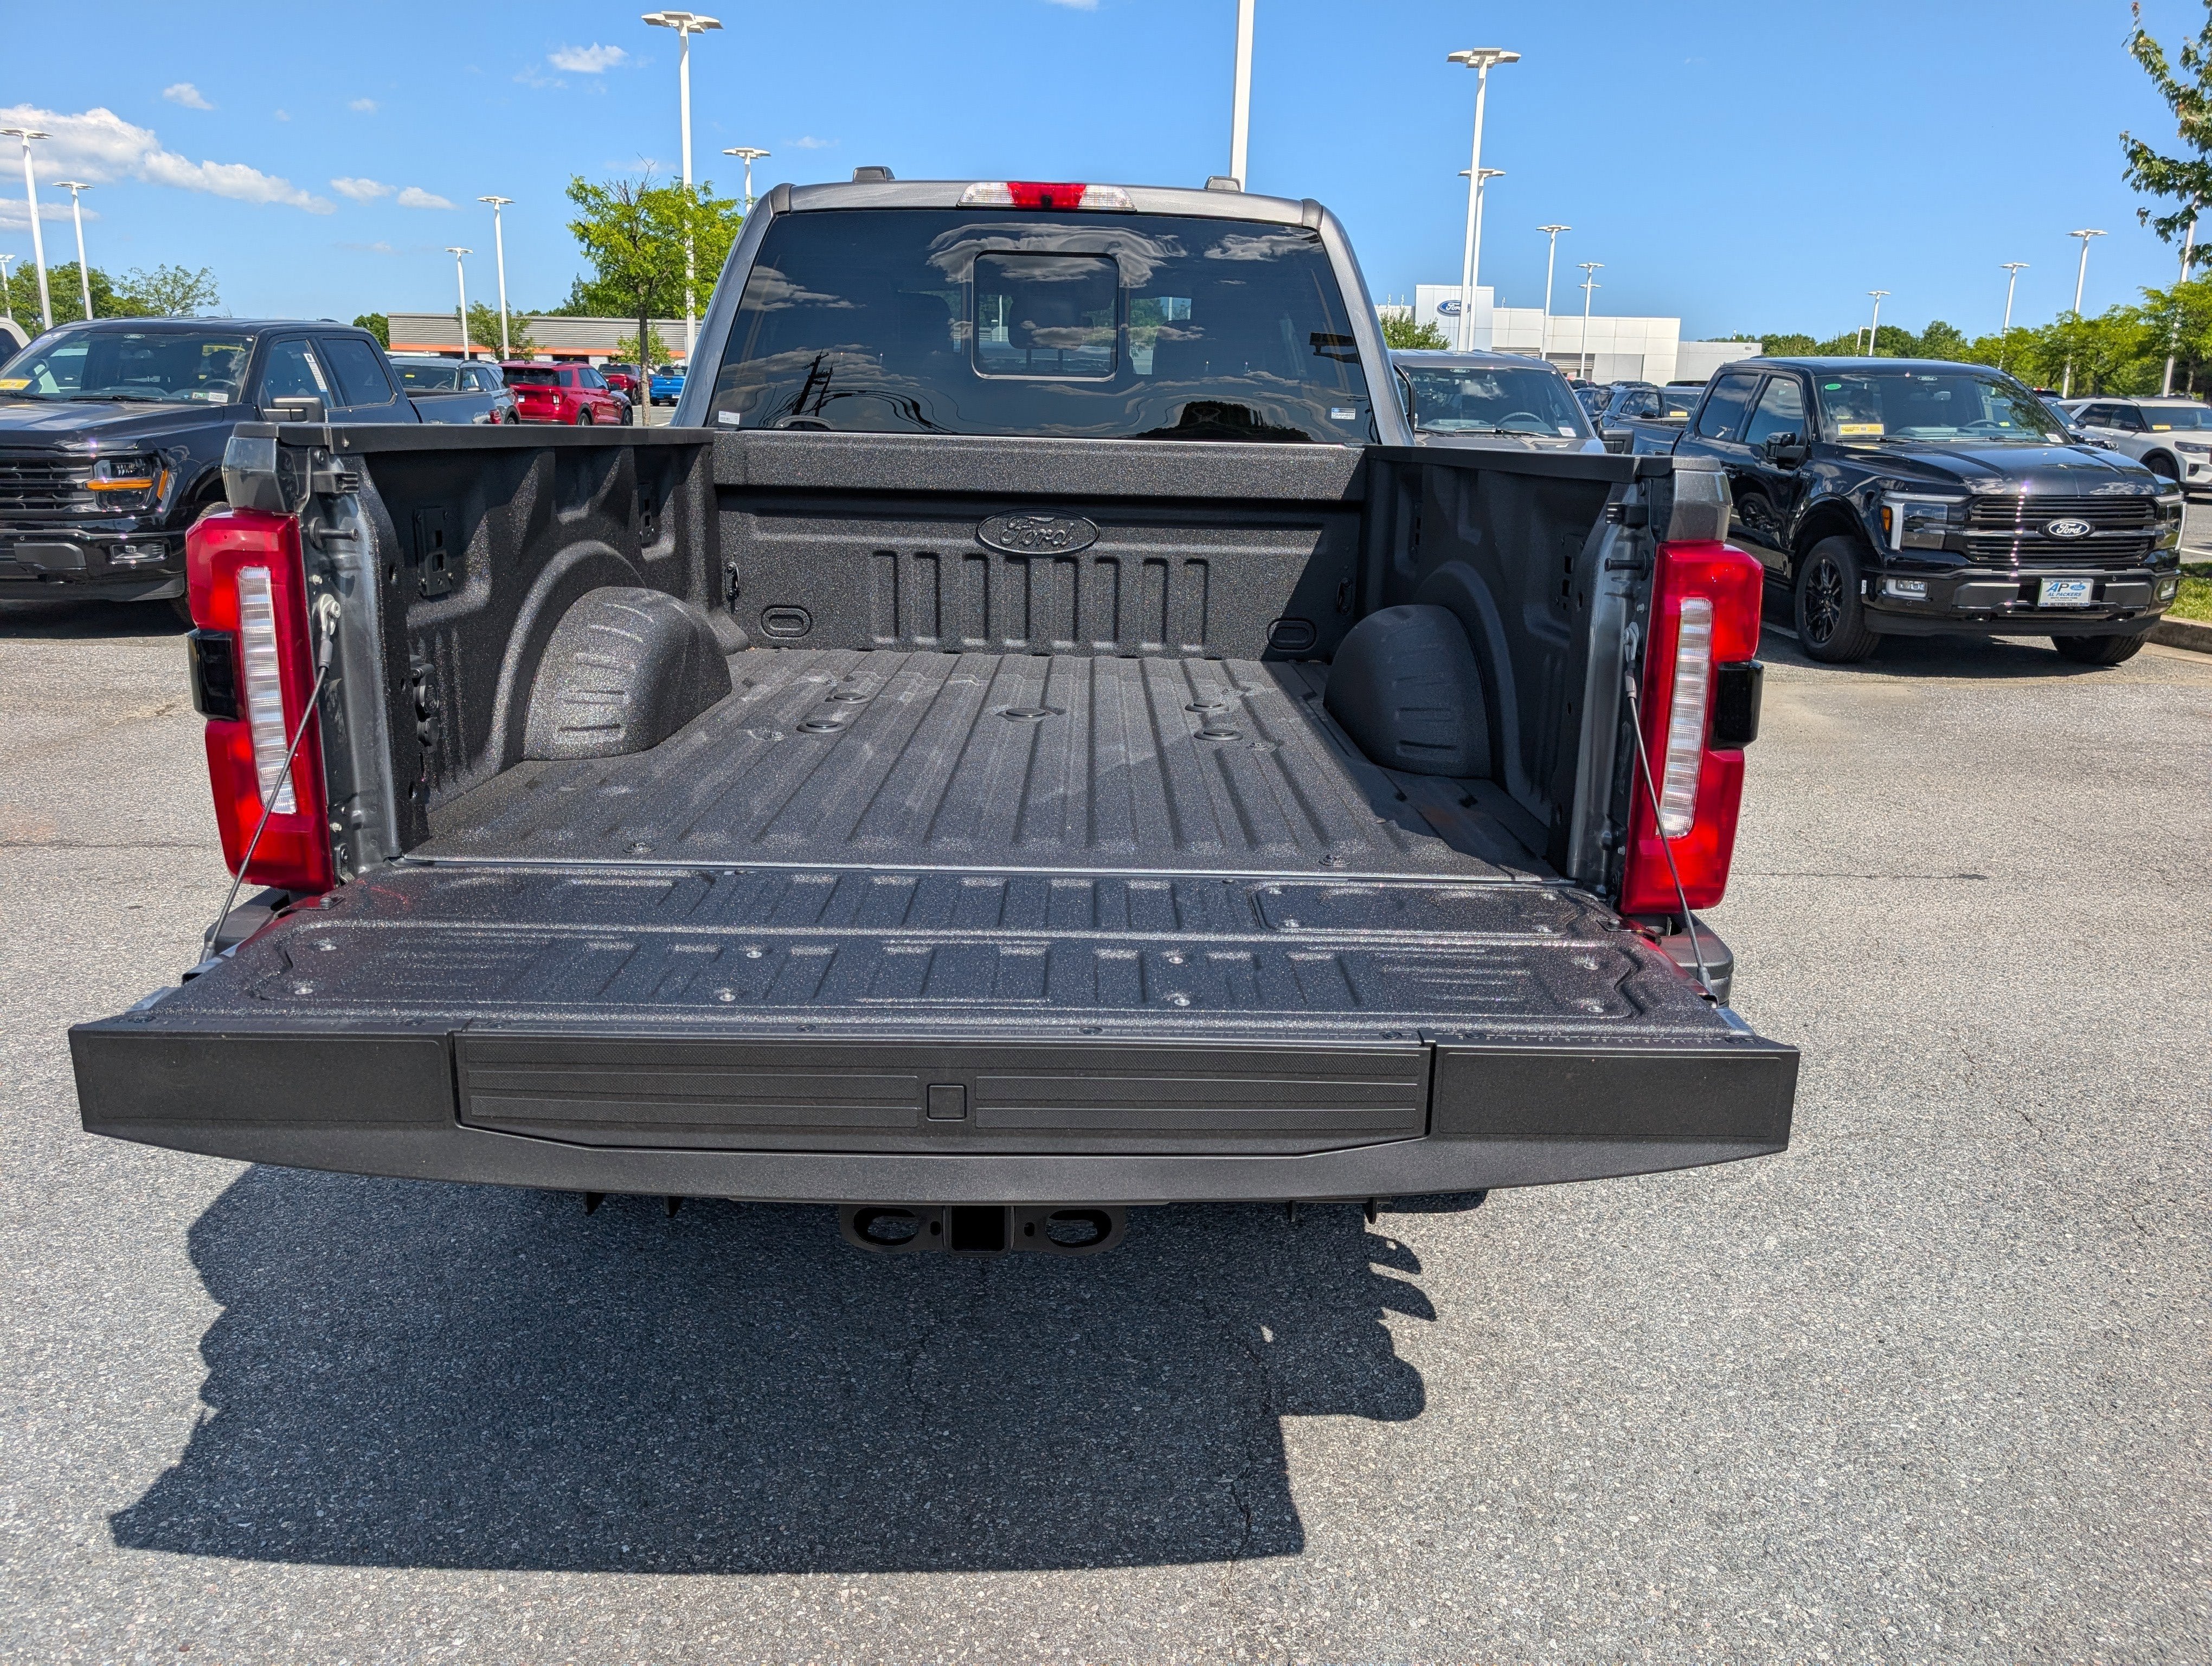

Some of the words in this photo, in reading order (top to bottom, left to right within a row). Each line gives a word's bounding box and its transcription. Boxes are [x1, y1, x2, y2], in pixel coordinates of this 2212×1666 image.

[1000, 516, 1074, 546] Ford
[2056, 523, 2082, 534] Ford
[2045, 582, 2069, 592] AP
